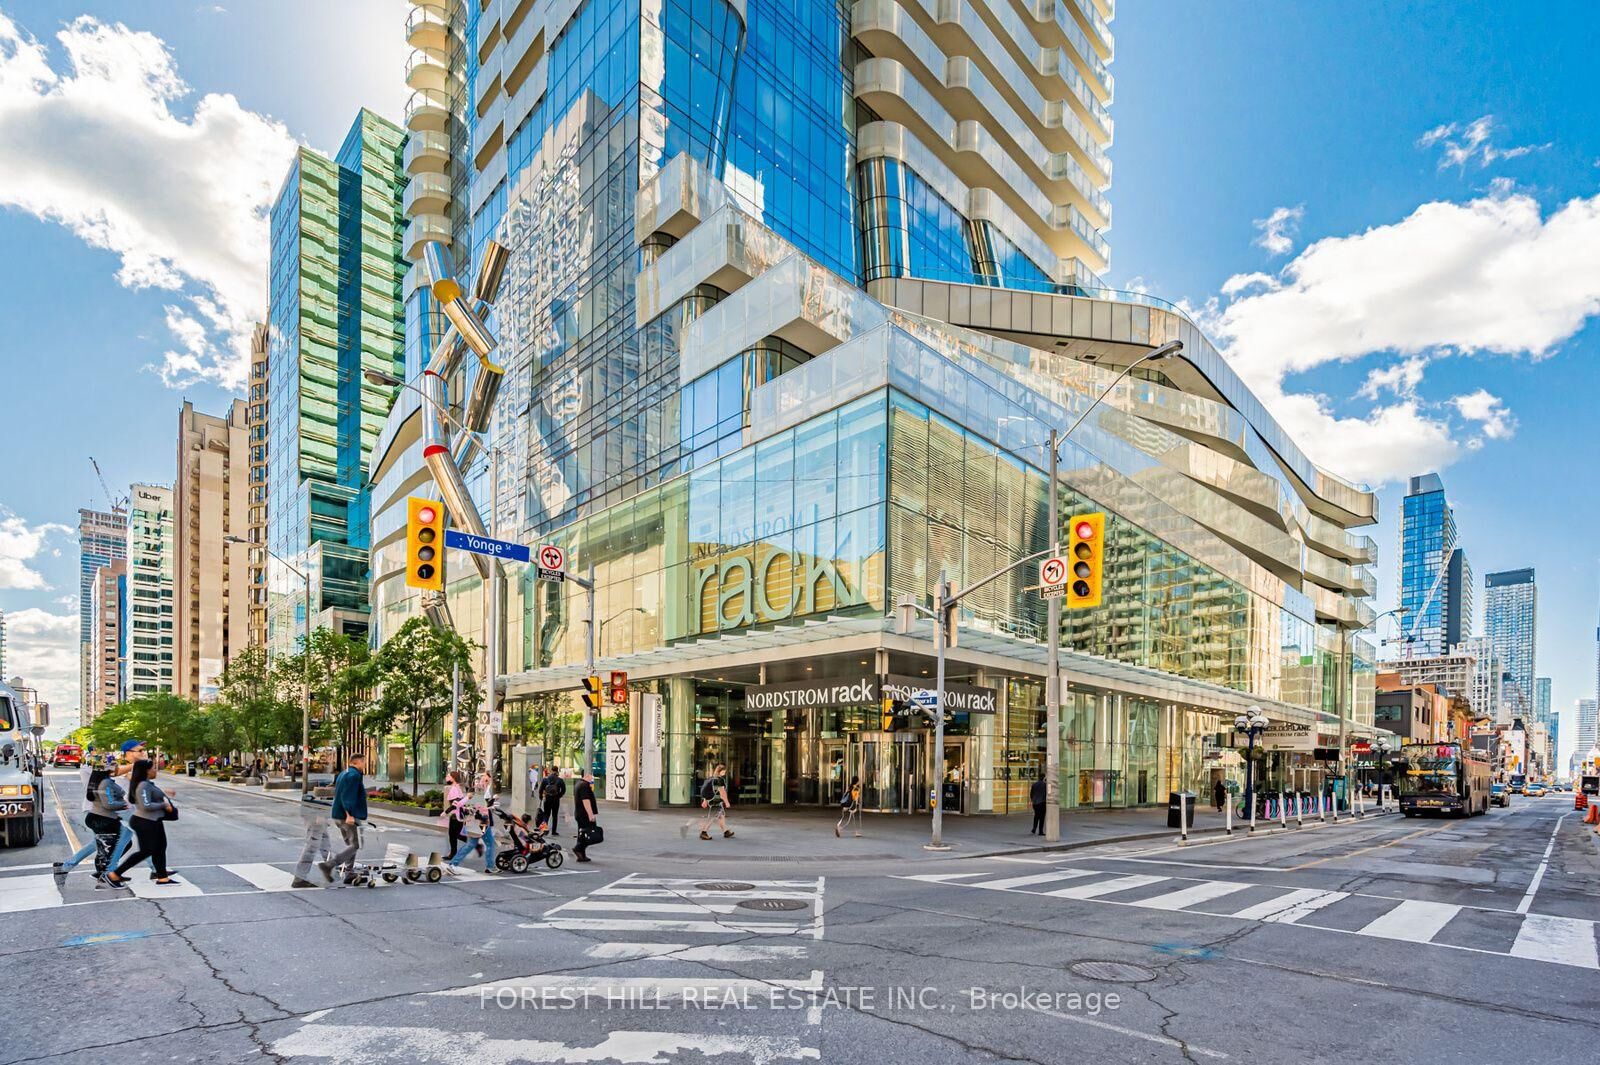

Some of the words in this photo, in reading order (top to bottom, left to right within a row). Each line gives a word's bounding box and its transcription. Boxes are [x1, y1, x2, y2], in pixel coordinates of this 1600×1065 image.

[138, 490, 161, 501] Uber
[466, 535, 503, 554] Yonge
[694, 503, 853, 635] rack
[746, 687, 828, 709] NORDSTROM
[831, 678, 874, 704] rack
[967, 691, 995, 712] rack
[611, 737, 626, 800] rack
